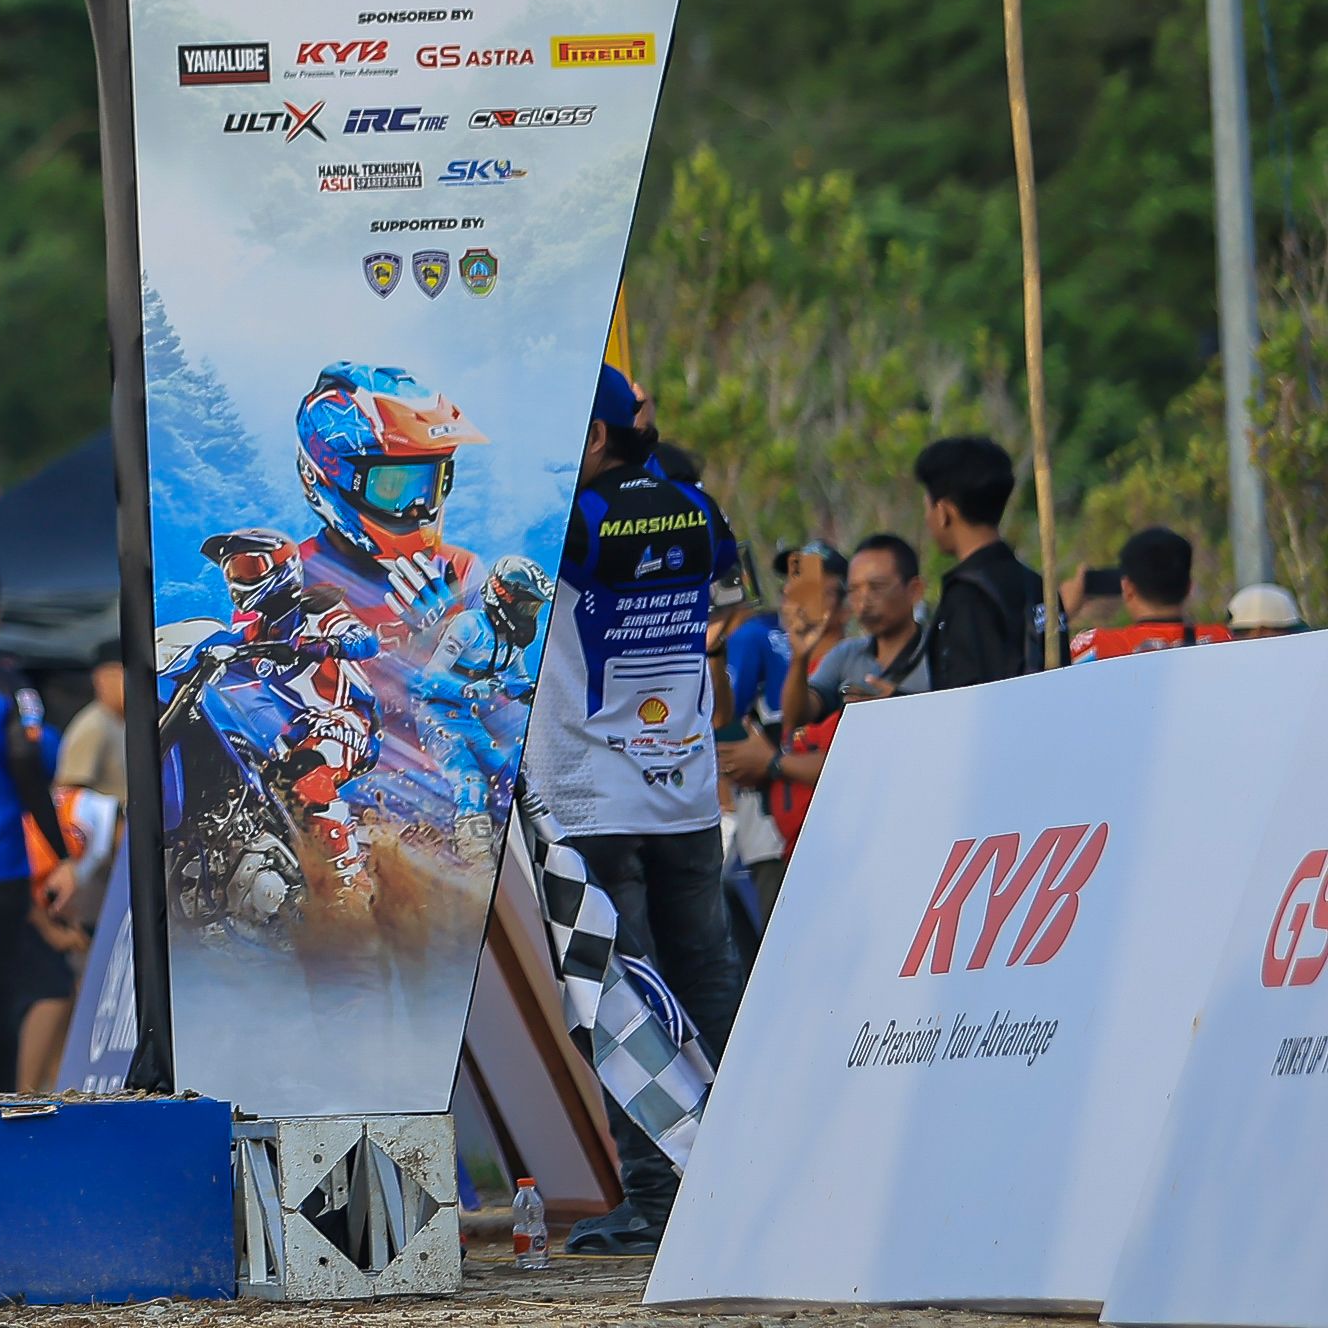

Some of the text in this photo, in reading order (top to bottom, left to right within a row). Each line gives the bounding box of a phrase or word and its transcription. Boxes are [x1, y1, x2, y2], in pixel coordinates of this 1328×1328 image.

[358, 10, 448, 25] SPONSORED
[184, 46, 266, 73] YAMALUBE
[296, 39, 390, 64] KYB
[416, 45, 535, 69] GS ASTRA
[558, 40, 646, 63] PIRELLI
[416, 114, 450, 132] TIRE
[467, 105, 598, 129] CARGLOSS
[318, 164, 360, 179] HANDAL
[437, 159, 512, 182] SKY
[319, 177, 353, 192] ASLI
[370, 218, 458, 233] SUPPORTED
[599, 509, 708, 538] MARSHALL
[897, 821, 1110, 979] KYB
[846, 1009, 1060, 1069] Our Precision, Your Advantage
[1270, 1036, 1314, 1077] POWER
